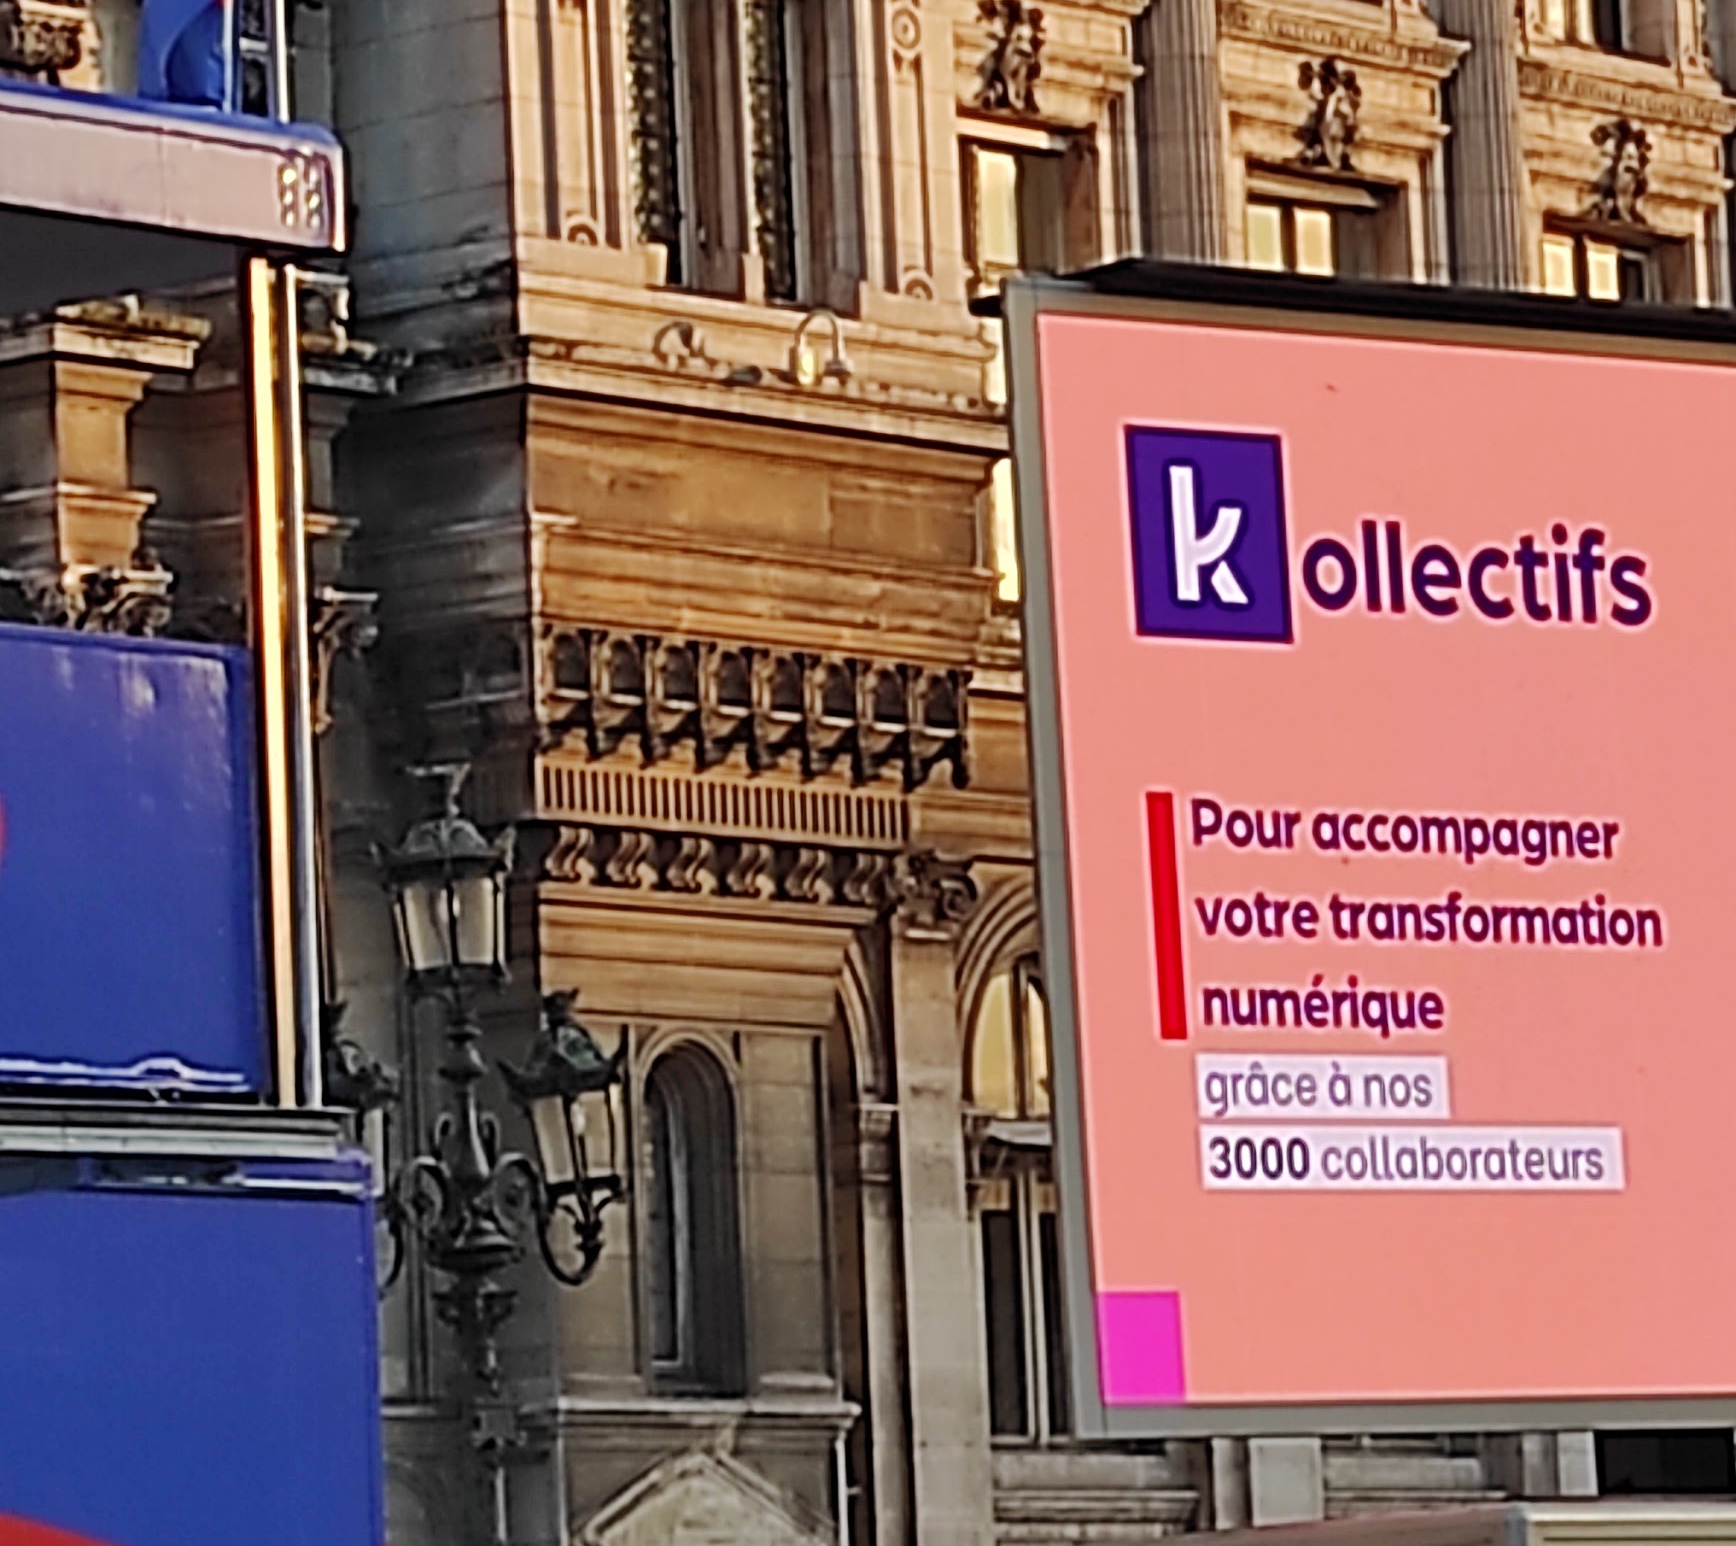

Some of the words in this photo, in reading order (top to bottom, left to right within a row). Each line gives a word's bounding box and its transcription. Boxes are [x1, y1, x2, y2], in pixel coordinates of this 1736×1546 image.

[1168, 465, 1653, 627] kollectifs
[1191, 798, 1301, 849] Pour
[1312, 811, 1619, 866] accompagner
[1195, 891, 1319, 939] votre
[1329, 890, 1663, 947] transformation
[1202, 974, 1446, 1038] numérique
[1205, 1061, 1318, 1118] grâce
[1328, 1062, 1352, 1107] à
[1363, 1072, 1433, 1108] nos
[1209, 1136, 1310, 1180] 3000
[1321, 1135, 1604, 1181] collaborateurs
